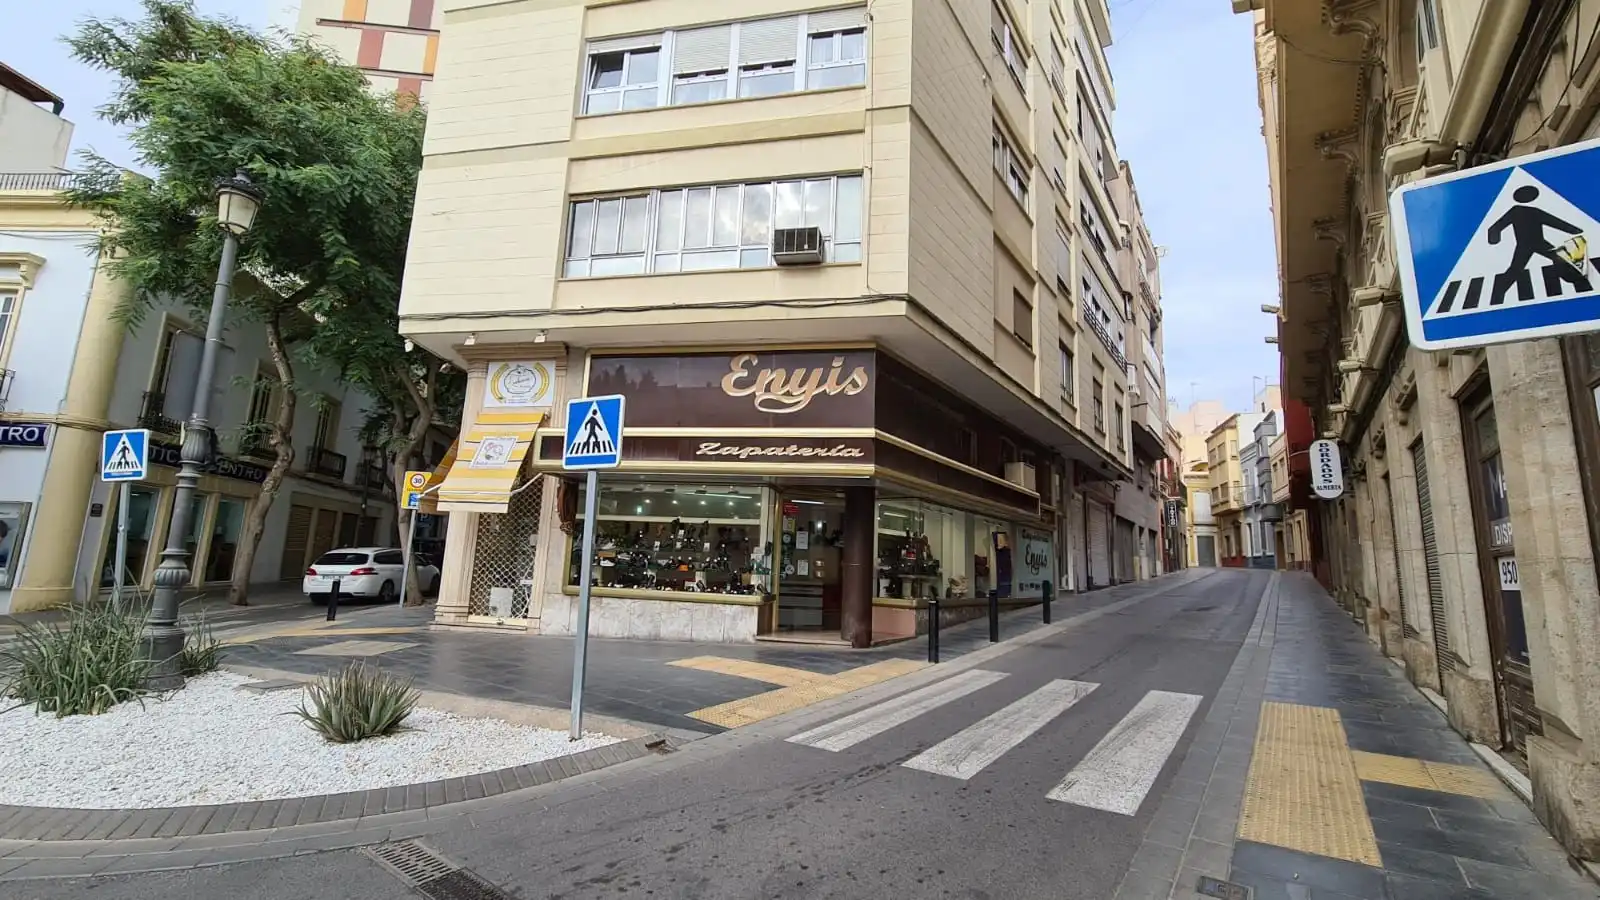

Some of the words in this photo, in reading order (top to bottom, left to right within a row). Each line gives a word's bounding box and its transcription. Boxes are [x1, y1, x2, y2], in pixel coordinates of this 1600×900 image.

[721, 353, 869, 413] Enyis
[149, 445, 178, 463] TIC
[216, 459, 263, 480] ENTRO
[1318, 443, 1333, 484] BORDADOS
[1494, 524, 1513, 545] DISP
[1025, 543, 1048, 576] Enyis
[1502, 560, 1518, 585] 950
